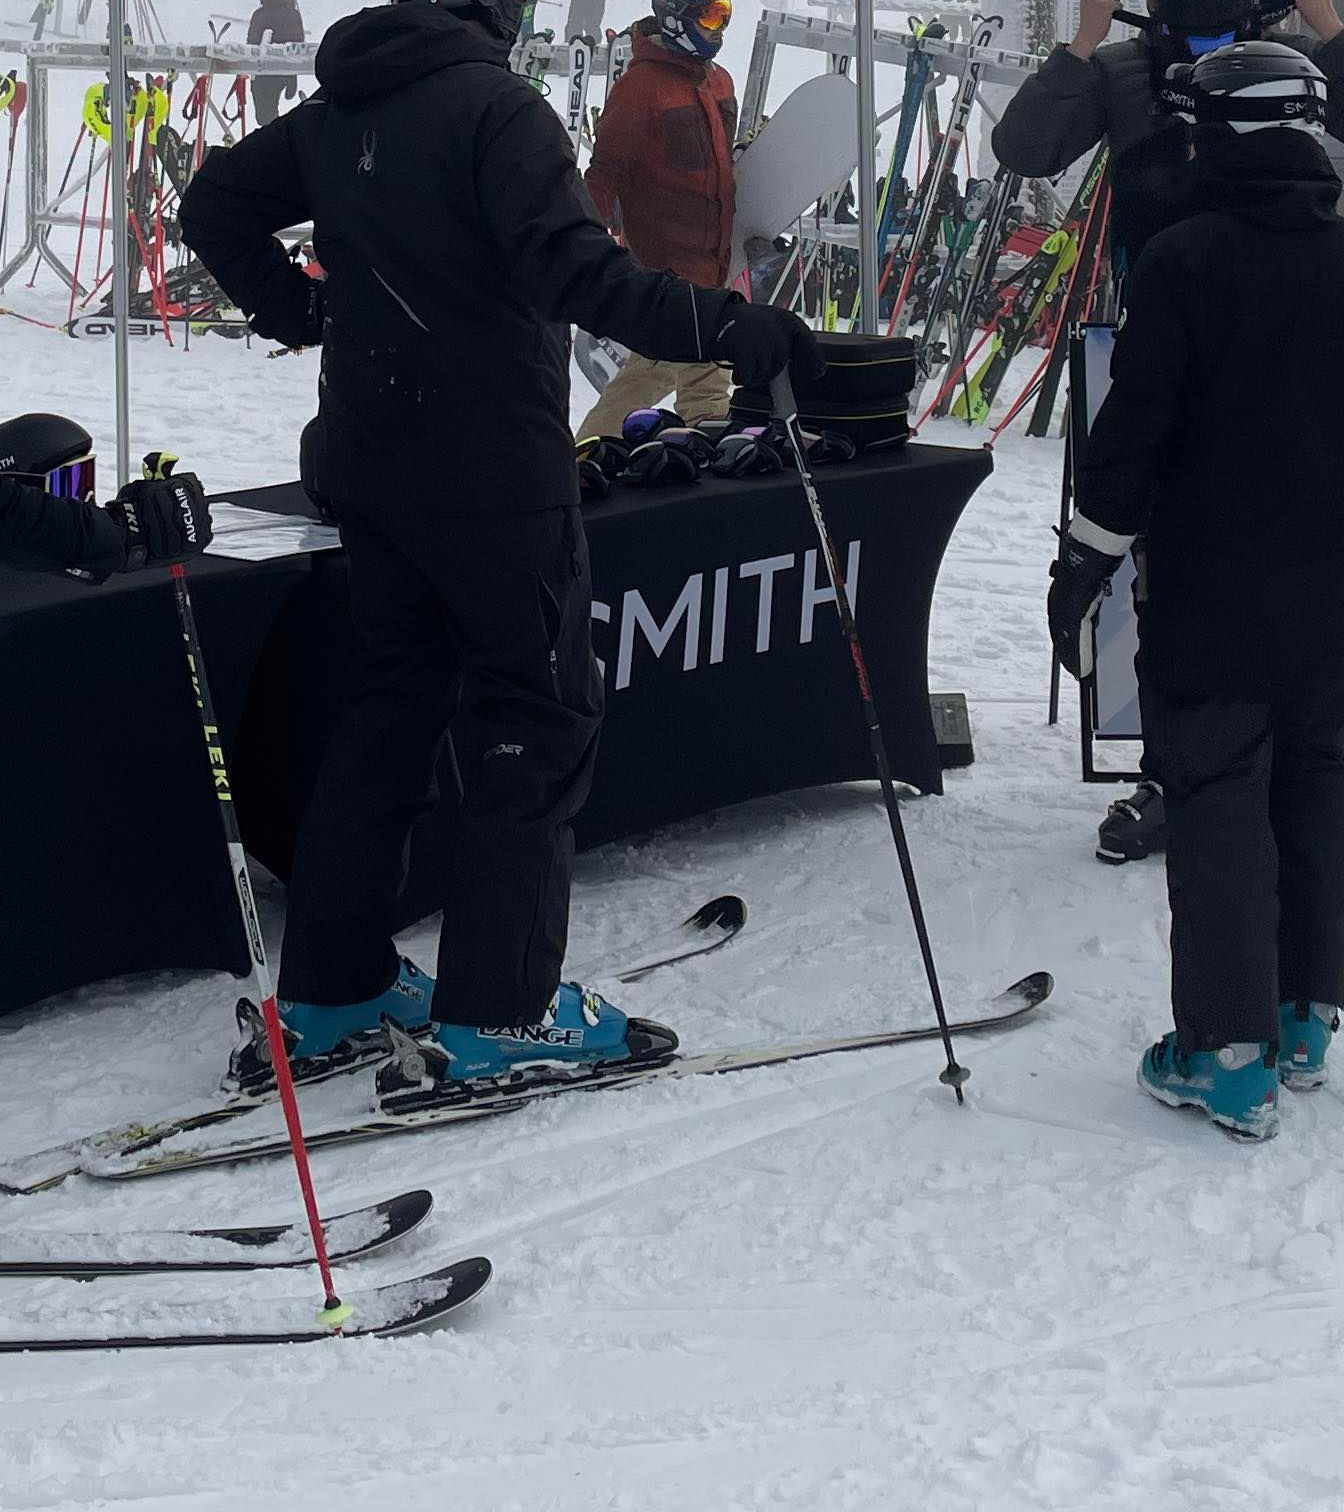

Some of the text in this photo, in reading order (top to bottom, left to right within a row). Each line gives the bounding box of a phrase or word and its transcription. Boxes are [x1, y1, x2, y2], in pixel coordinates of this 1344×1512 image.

[567, 48, 585, 132] HEAD
[1161, 89, 1196, 109] SMITH
[1283, 101, 1326, 117] SMH
[174, 487, 197, 543] AUCLAIR
[203, 724, 232, 801] LEKI
